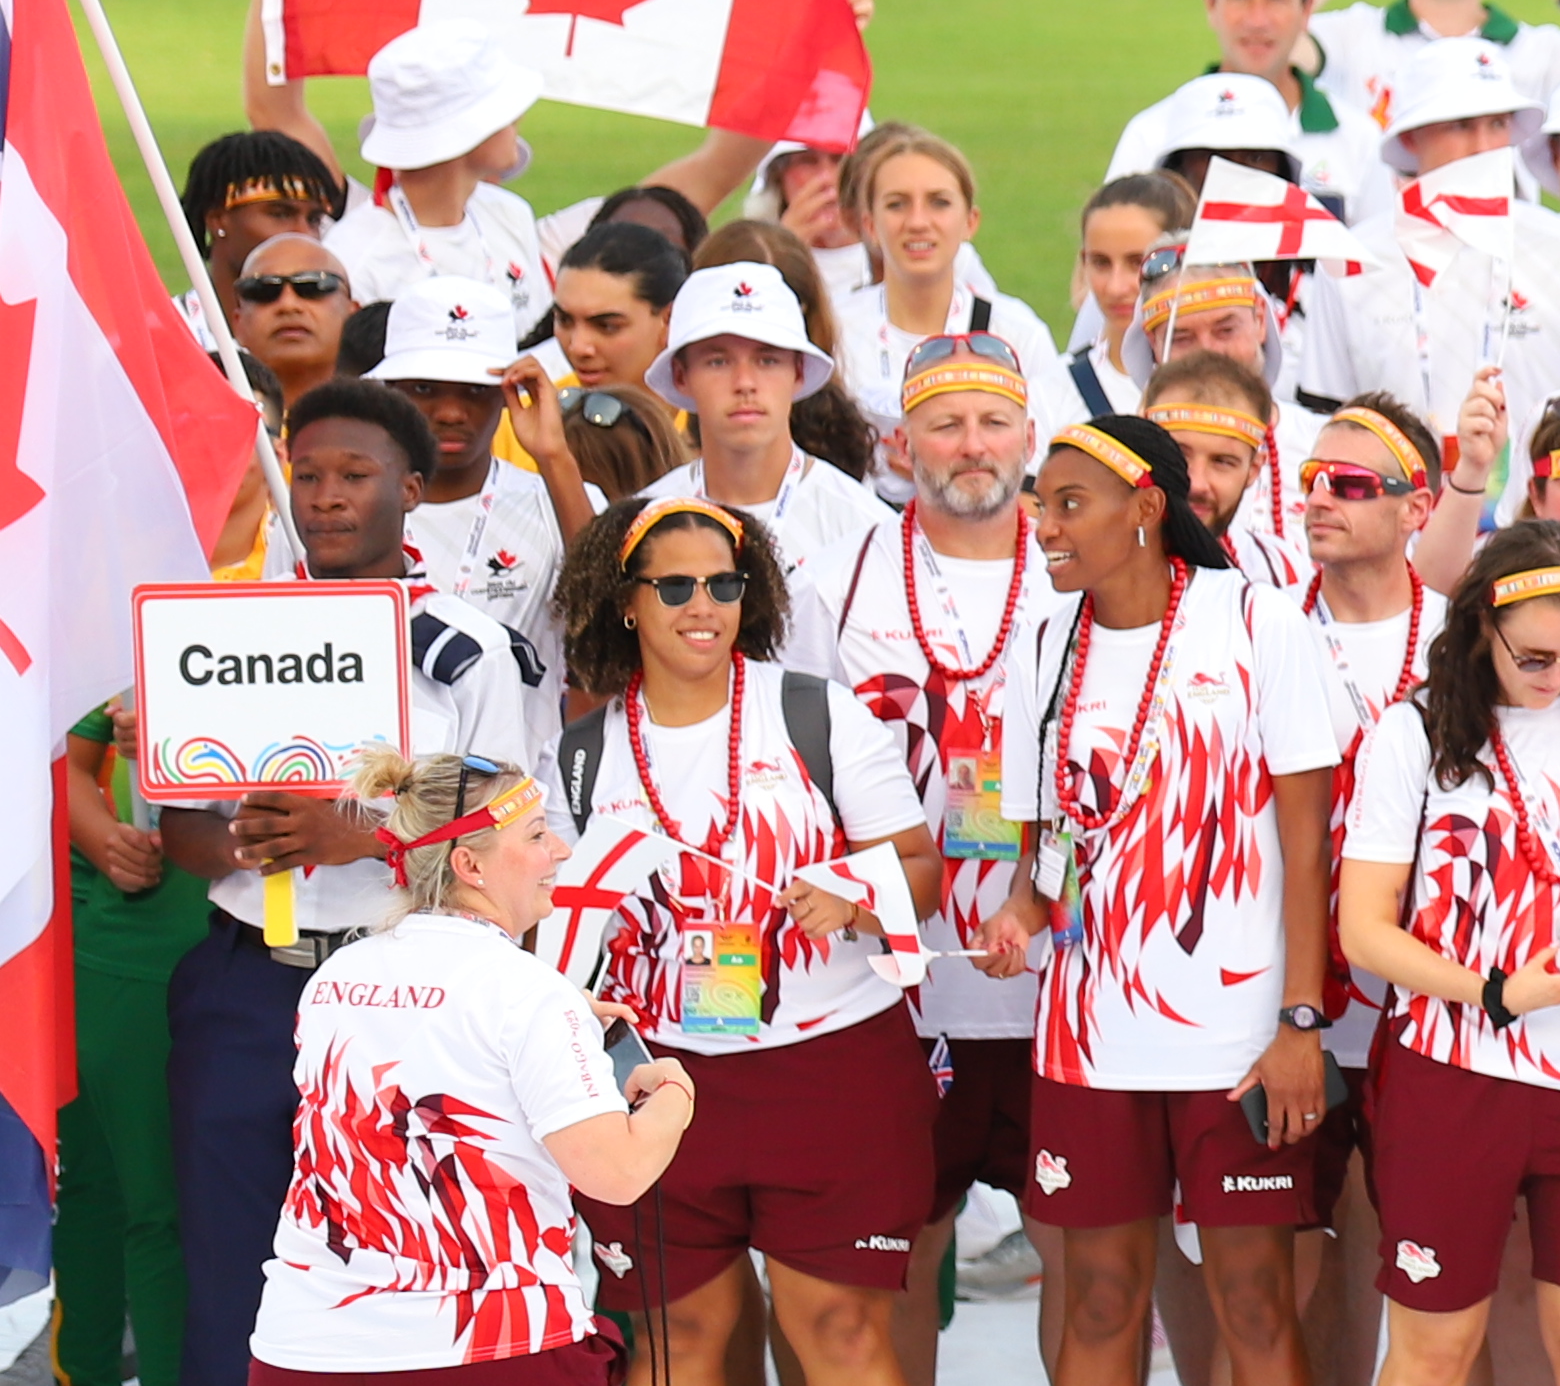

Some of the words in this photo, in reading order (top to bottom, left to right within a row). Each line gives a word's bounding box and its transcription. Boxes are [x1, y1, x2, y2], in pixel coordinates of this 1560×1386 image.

[885, 627, 943, 641] KURI
[179, 641, 364, 686] Canada
[570, 749, 587, 815] ENGLAND
[312, 981, 446, 1009] ENGLAND
[572, 1041, 599, 1098] INBAGO
[1237, 1175, 1293, 1191] KUKRI
